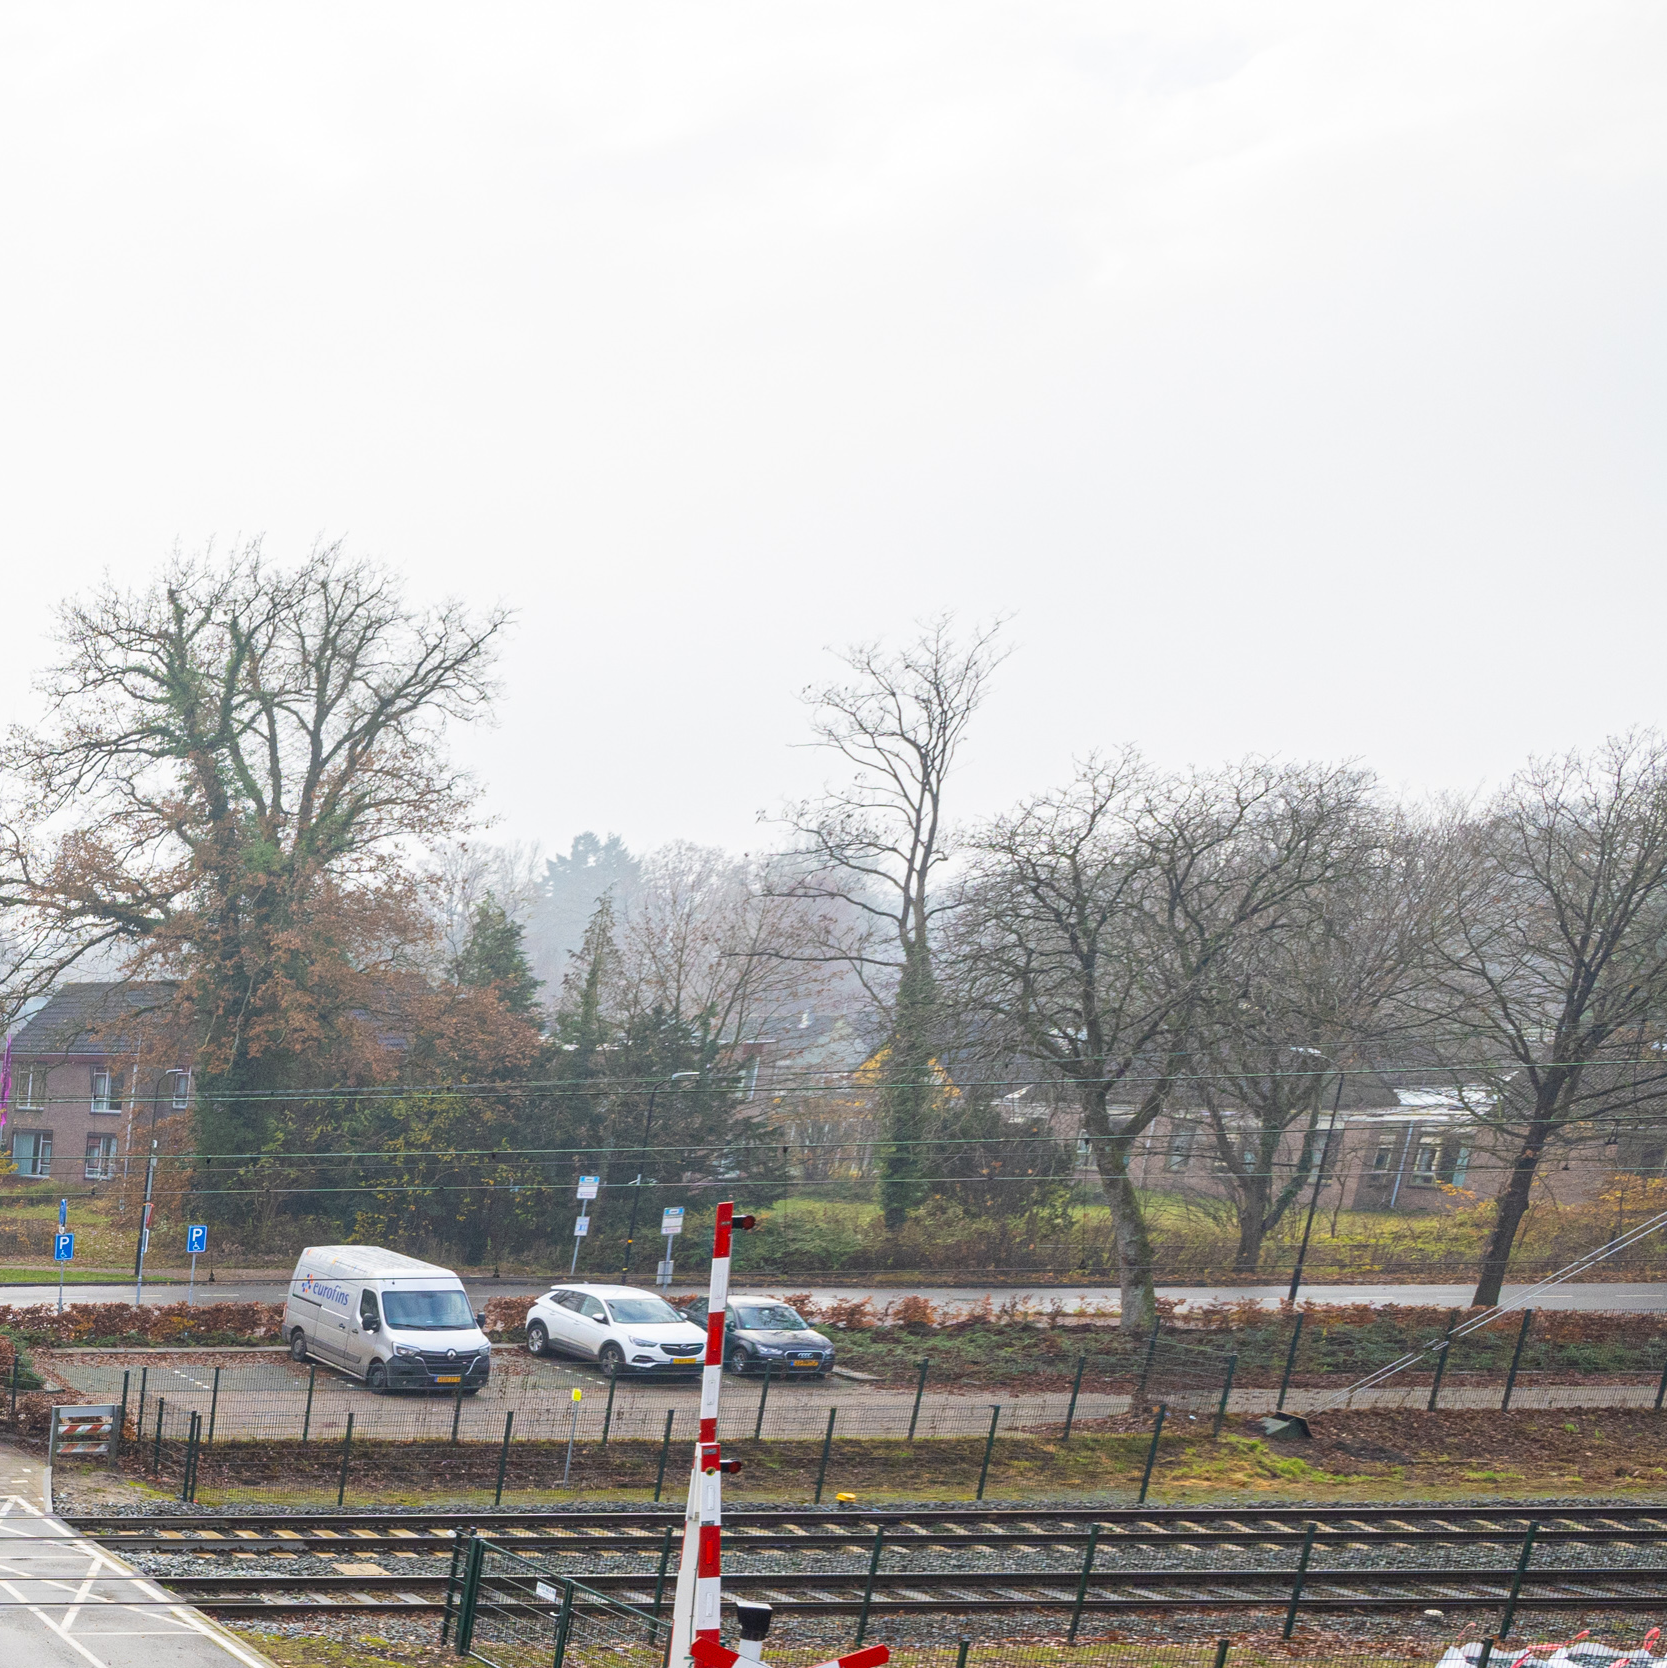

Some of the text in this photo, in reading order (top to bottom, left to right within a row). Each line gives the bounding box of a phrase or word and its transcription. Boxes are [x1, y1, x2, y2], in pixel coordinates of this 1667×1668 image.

[192, 1228, 203, 1241] P
[59, 1236, 70, 1250] P
[312, 1282, 350, 1306] eurofins
